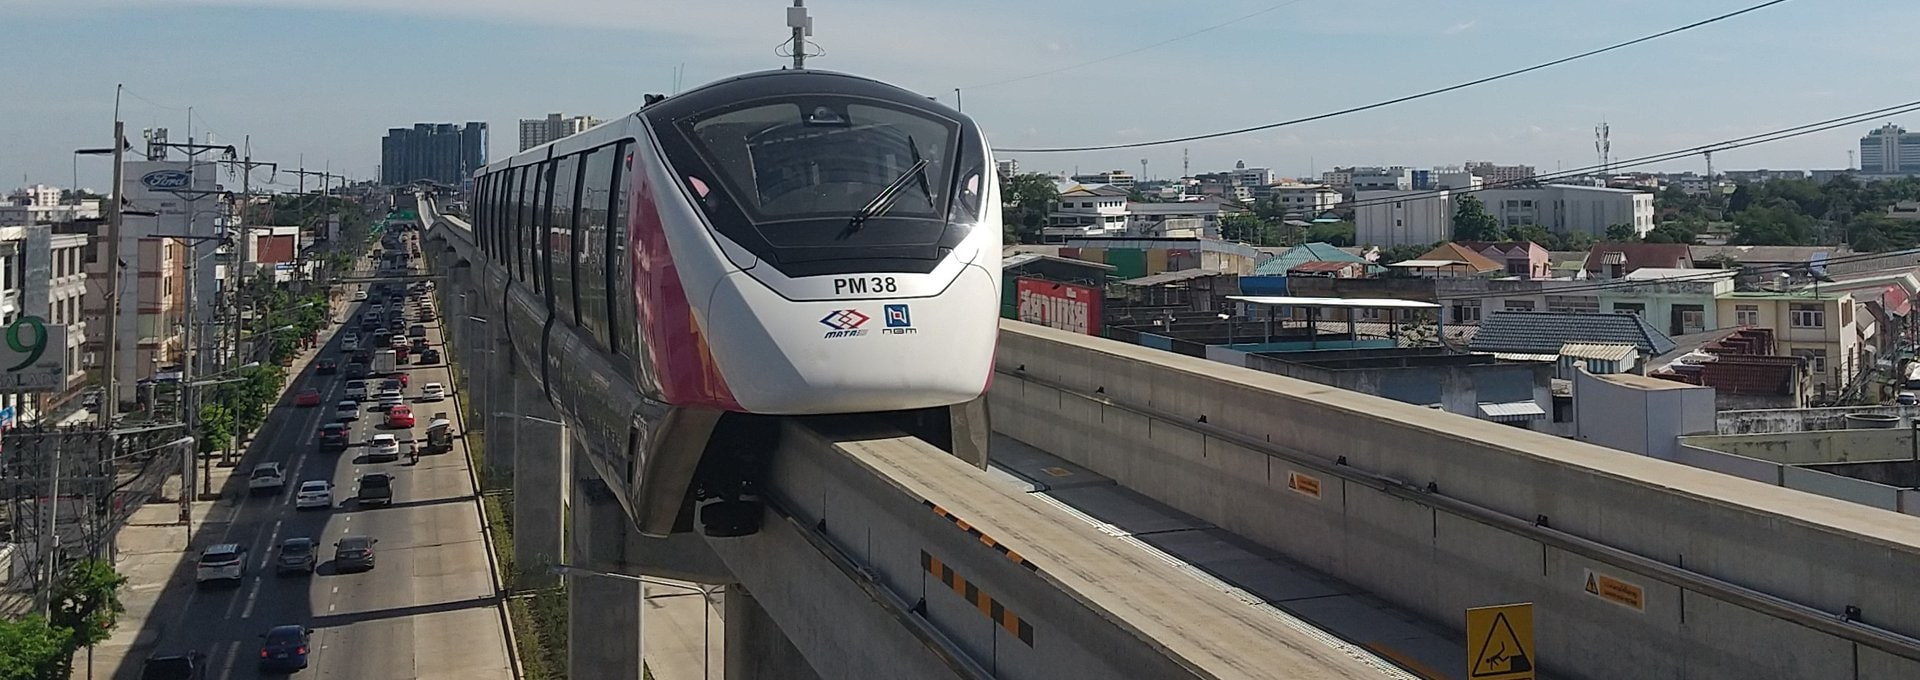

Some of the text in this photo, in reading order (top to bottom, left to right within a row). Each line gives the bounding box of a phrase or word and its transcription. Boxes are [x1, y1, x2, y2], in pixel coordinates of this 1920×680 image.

[150, 173, 186, 186] Ford
[834, 277, 897, 294] PM 38
[6, 315, 48, 372] 9
